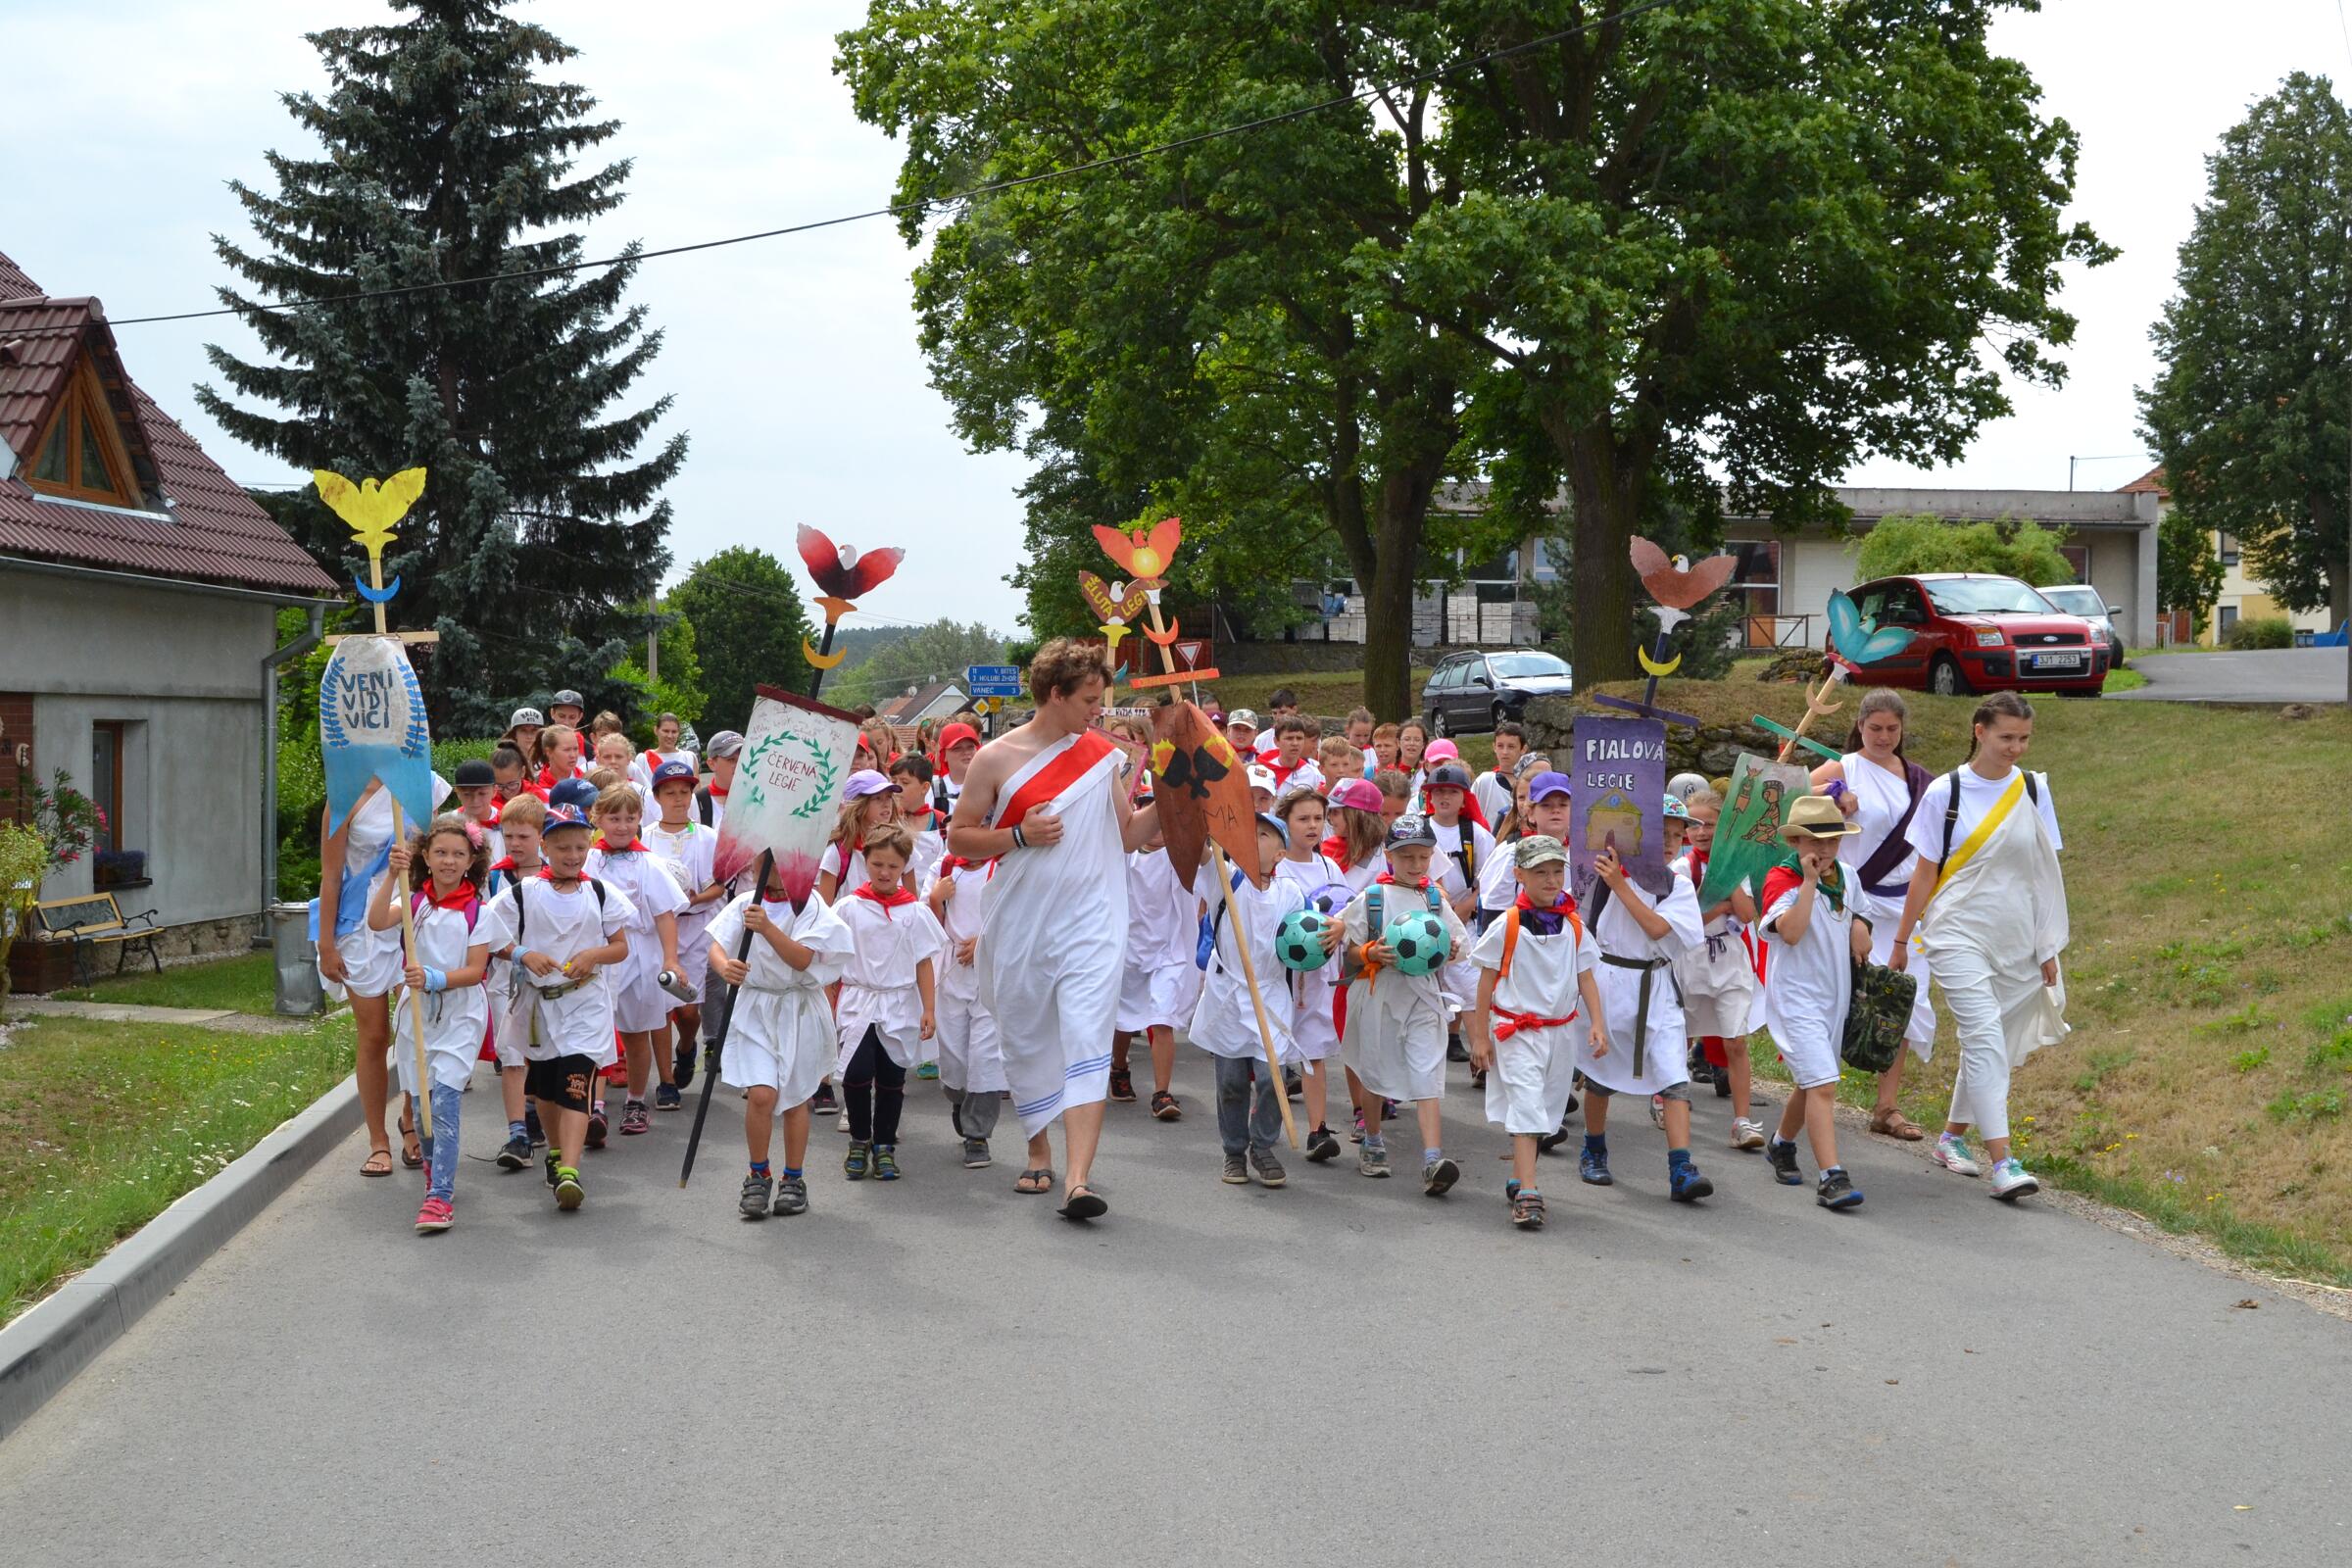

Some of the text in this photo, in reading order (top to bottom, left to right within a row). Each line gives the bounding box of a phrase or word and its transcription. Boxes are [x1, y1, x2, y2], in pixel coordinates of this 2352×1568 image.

[2039, 655, 2077, 664] 3J1 2253
[1586, 738, 1665, 761] FIALOVÁ
[767, 751, 818, 778] ČERVENÁ
[768, 771, 802, 792] LEGIE
